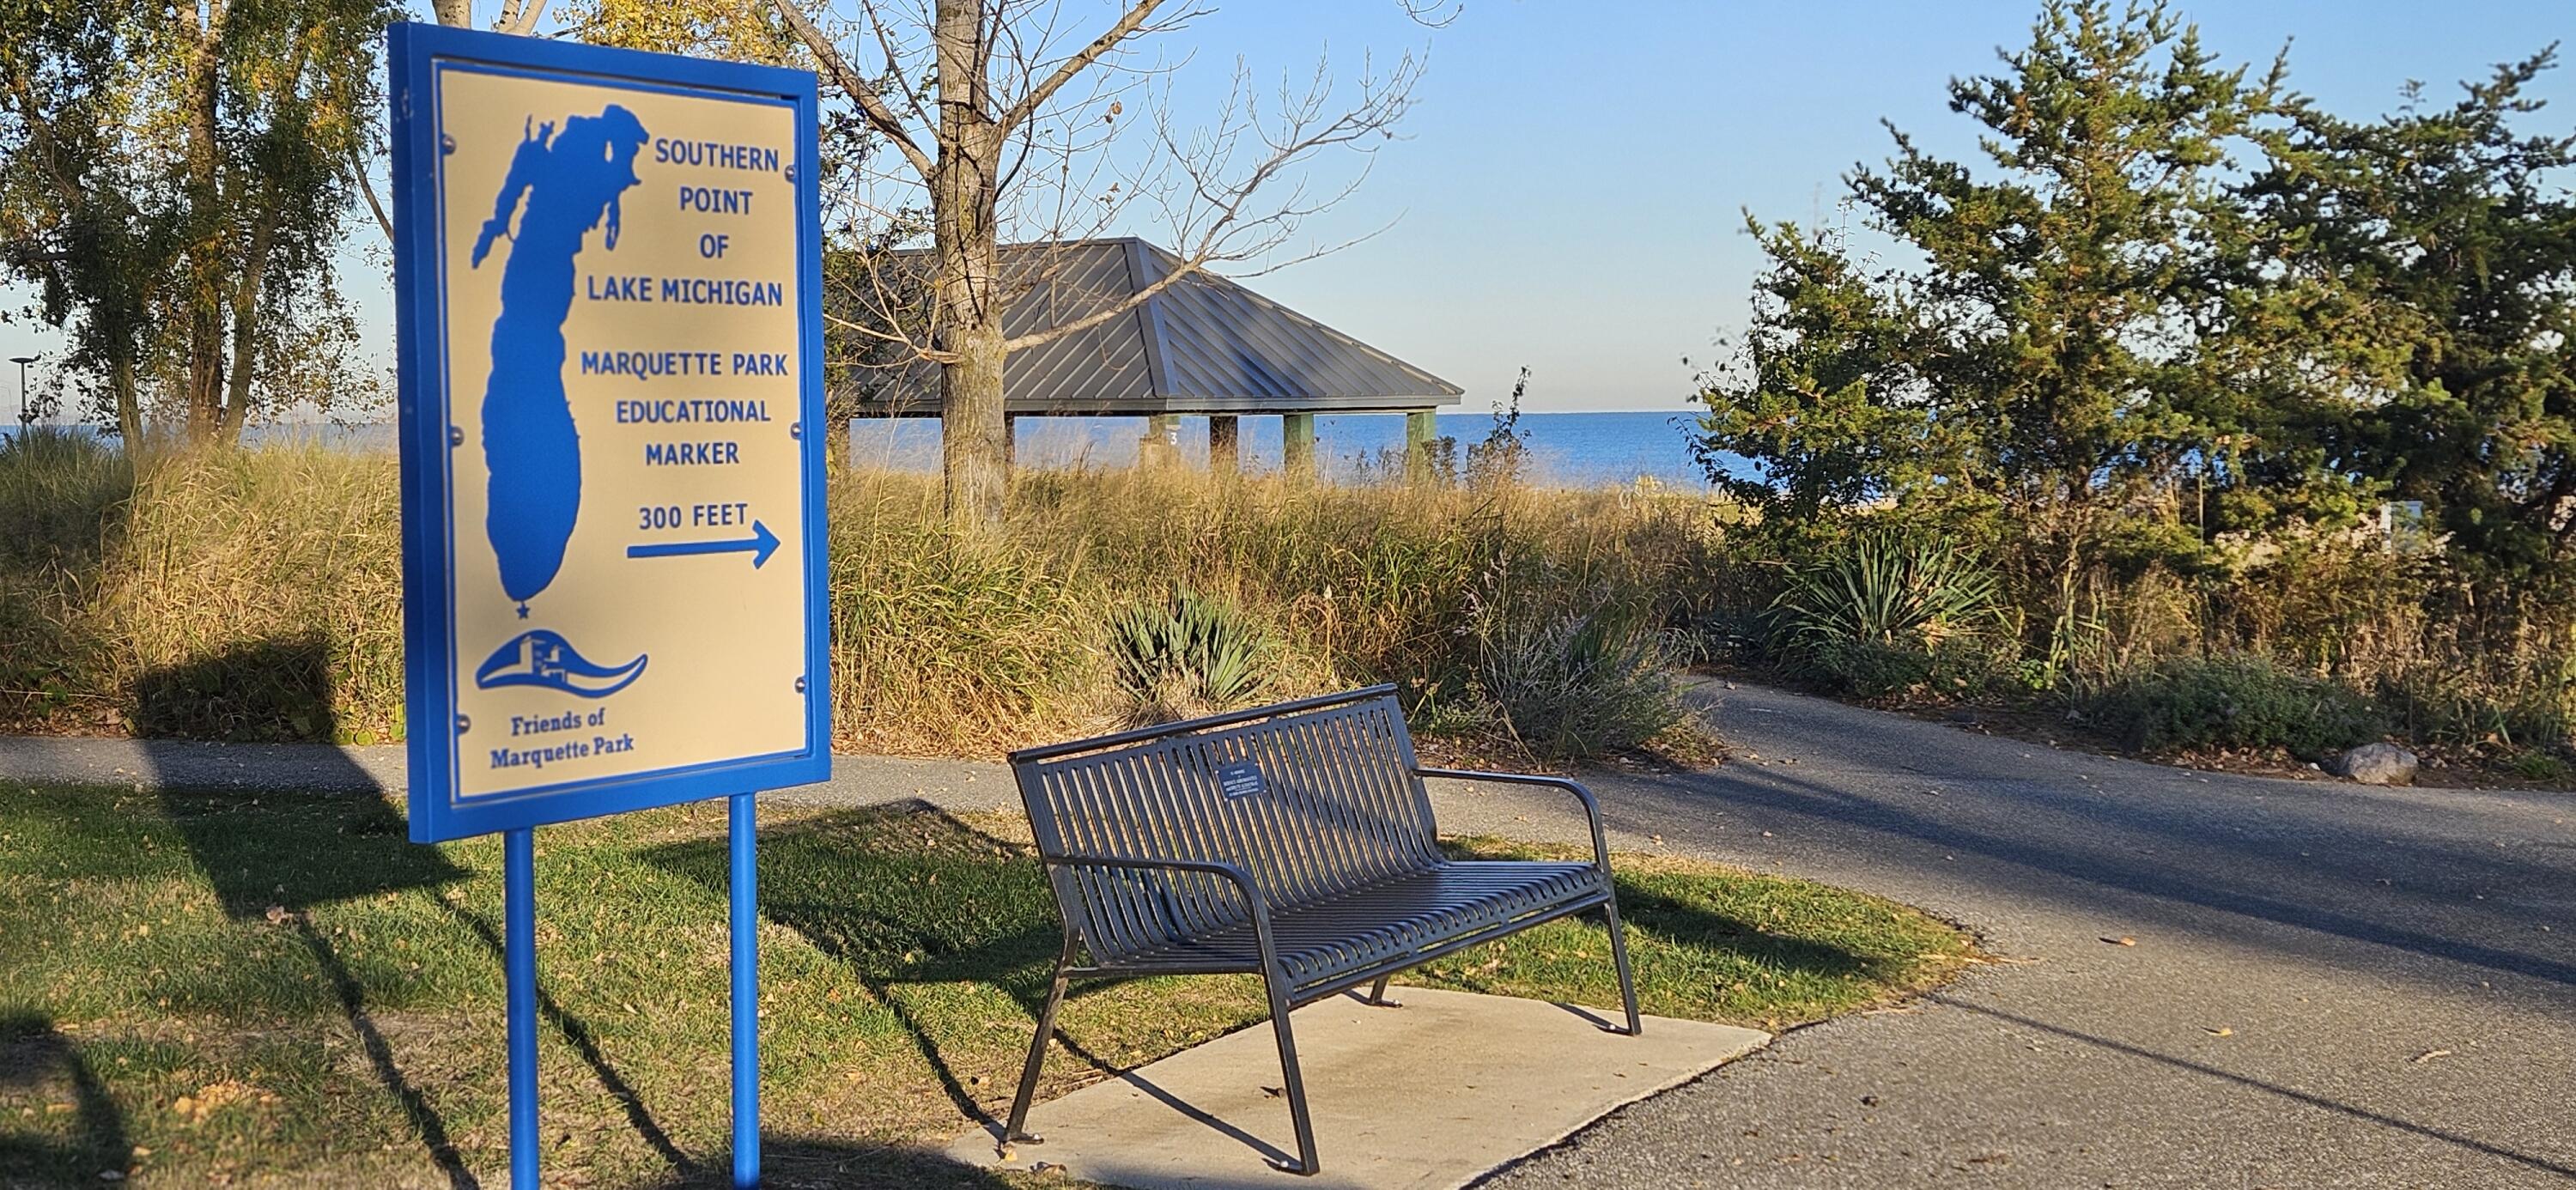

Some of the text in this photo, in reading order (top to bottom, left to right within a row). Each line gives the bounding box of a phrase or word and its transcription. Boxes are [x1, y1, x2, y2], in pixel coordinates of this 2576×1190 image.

[656, 138, 779, 171] SOUTHERN
[680, 186, 753, 214] POINT
[700, 234, 729, 258] OF
[588, 276, 783, 307] LAKE MICHIGAN
[581, 352, 788, 379] MARQUETTE PARK
[617, 399, 771, 423] EDUCATIONAL
[1170, 432, 1178, 446] 3
[647, 442, 739, 465] MARKER
[639, 503, 748, 530] 300 FEET
[511, 708, 606, 736] Friends of
[490, 734, 634, 768] Marquette Park
